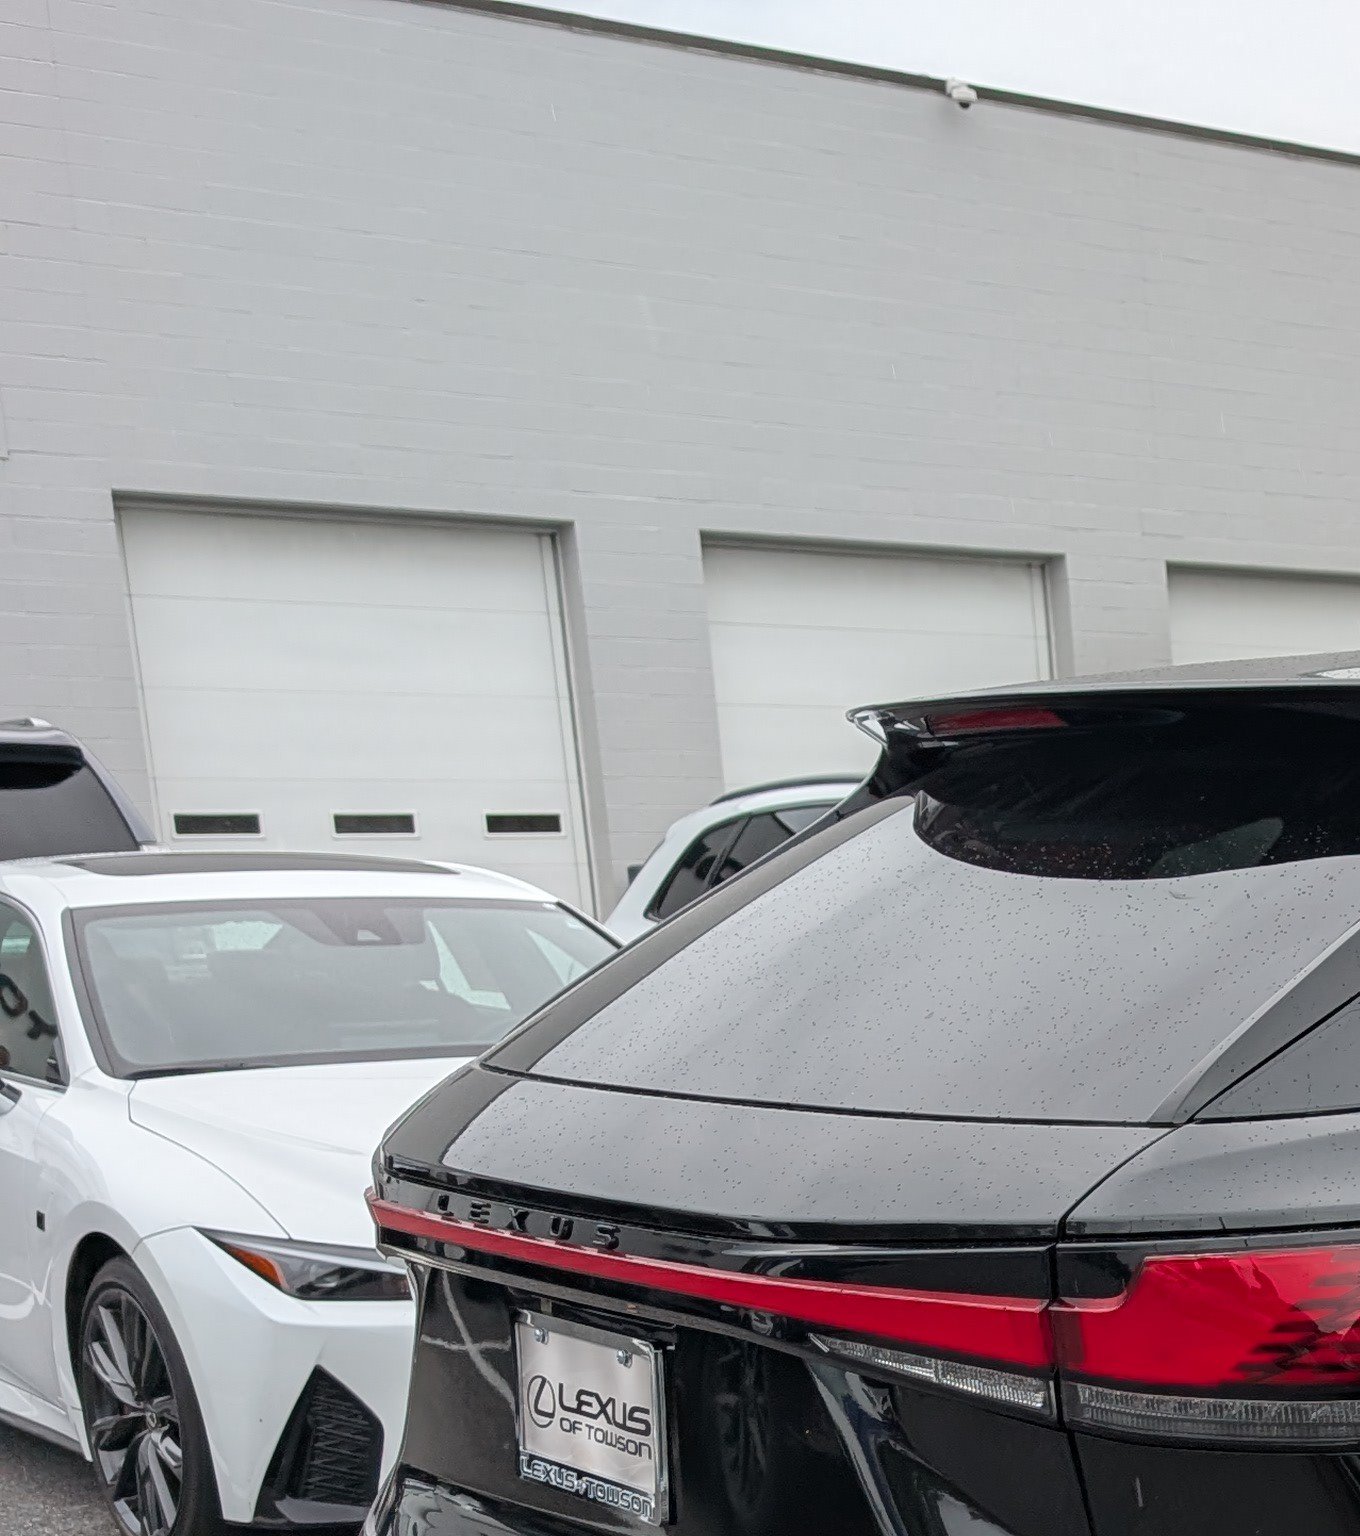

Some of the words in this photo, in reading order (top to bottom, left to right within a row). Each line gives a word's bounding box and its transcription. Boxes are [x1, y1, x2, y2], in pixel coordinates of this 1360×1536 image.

[437, 1194, 621, 1250] LEXUS
[558, 1382, 652, 1437] LEXUS
[559, 1416, 583, 1435] OF
[584, 1422, 652, 1460] TOWSON
[520, 1455, 578, 1491] LEXUS
[584, 1477, 654, 1519] TOWSON
